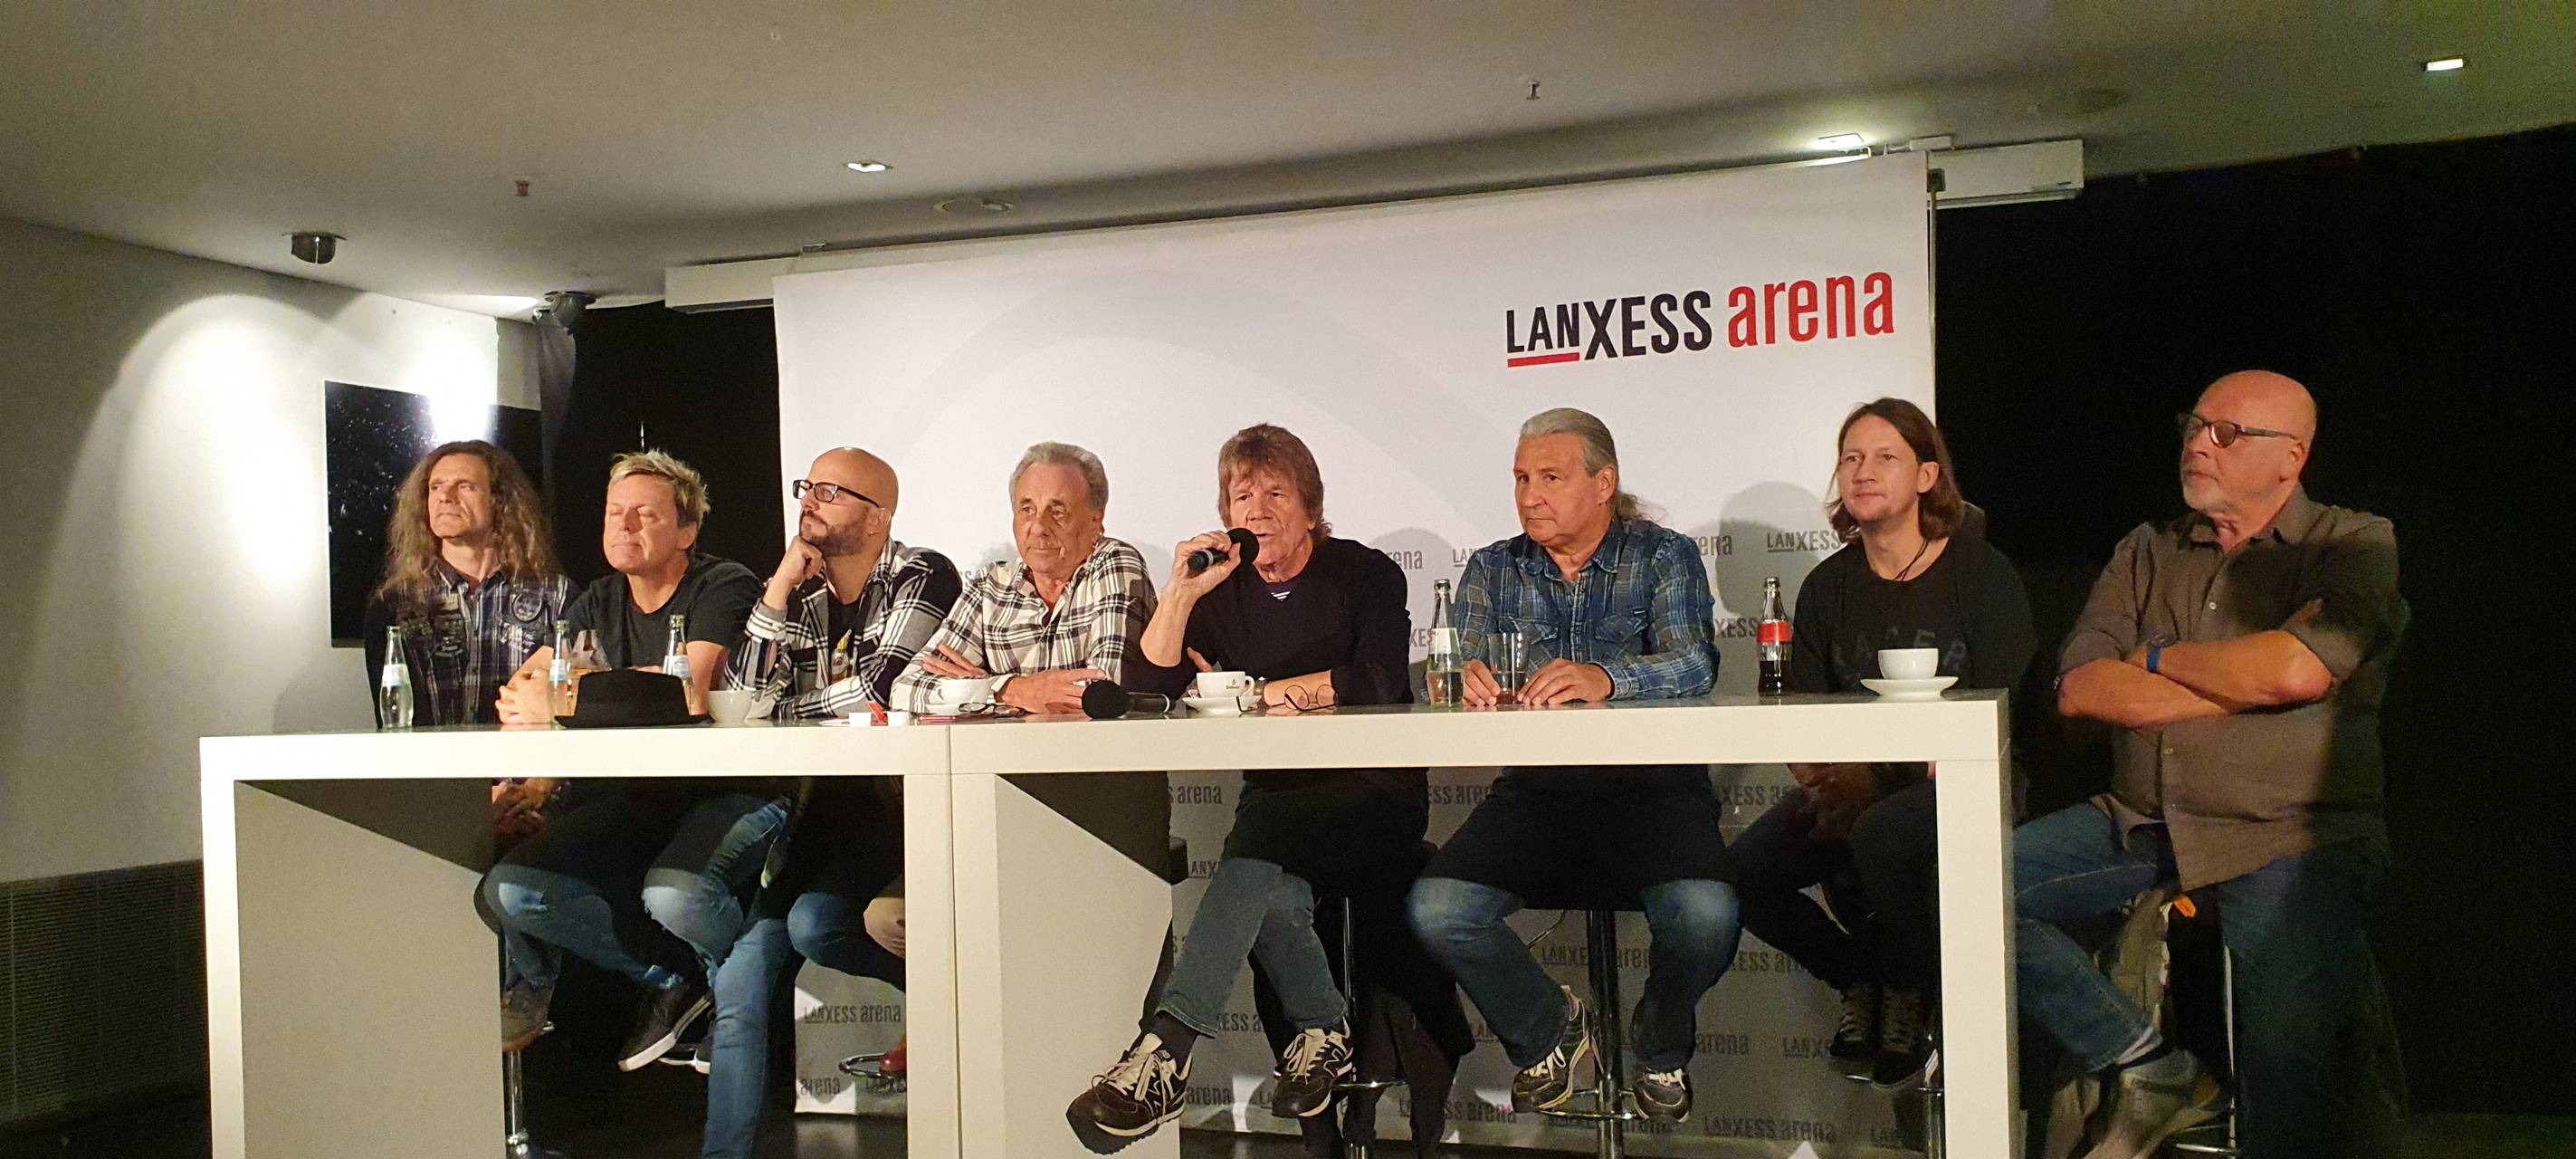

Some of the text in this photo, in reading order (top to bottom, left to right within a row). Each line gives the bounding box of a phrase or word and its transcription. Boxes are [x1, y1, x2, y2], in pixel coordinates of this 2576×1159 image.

[1506, 272, 1894, 361] LANXESS arena
[1178, 784, 1222, 805] arena
[804, 1004, 902, 1024] LANXESS arena
[799, 1077, 841, 1096] arena
[1187, 1087, 1232, 1106] arena
